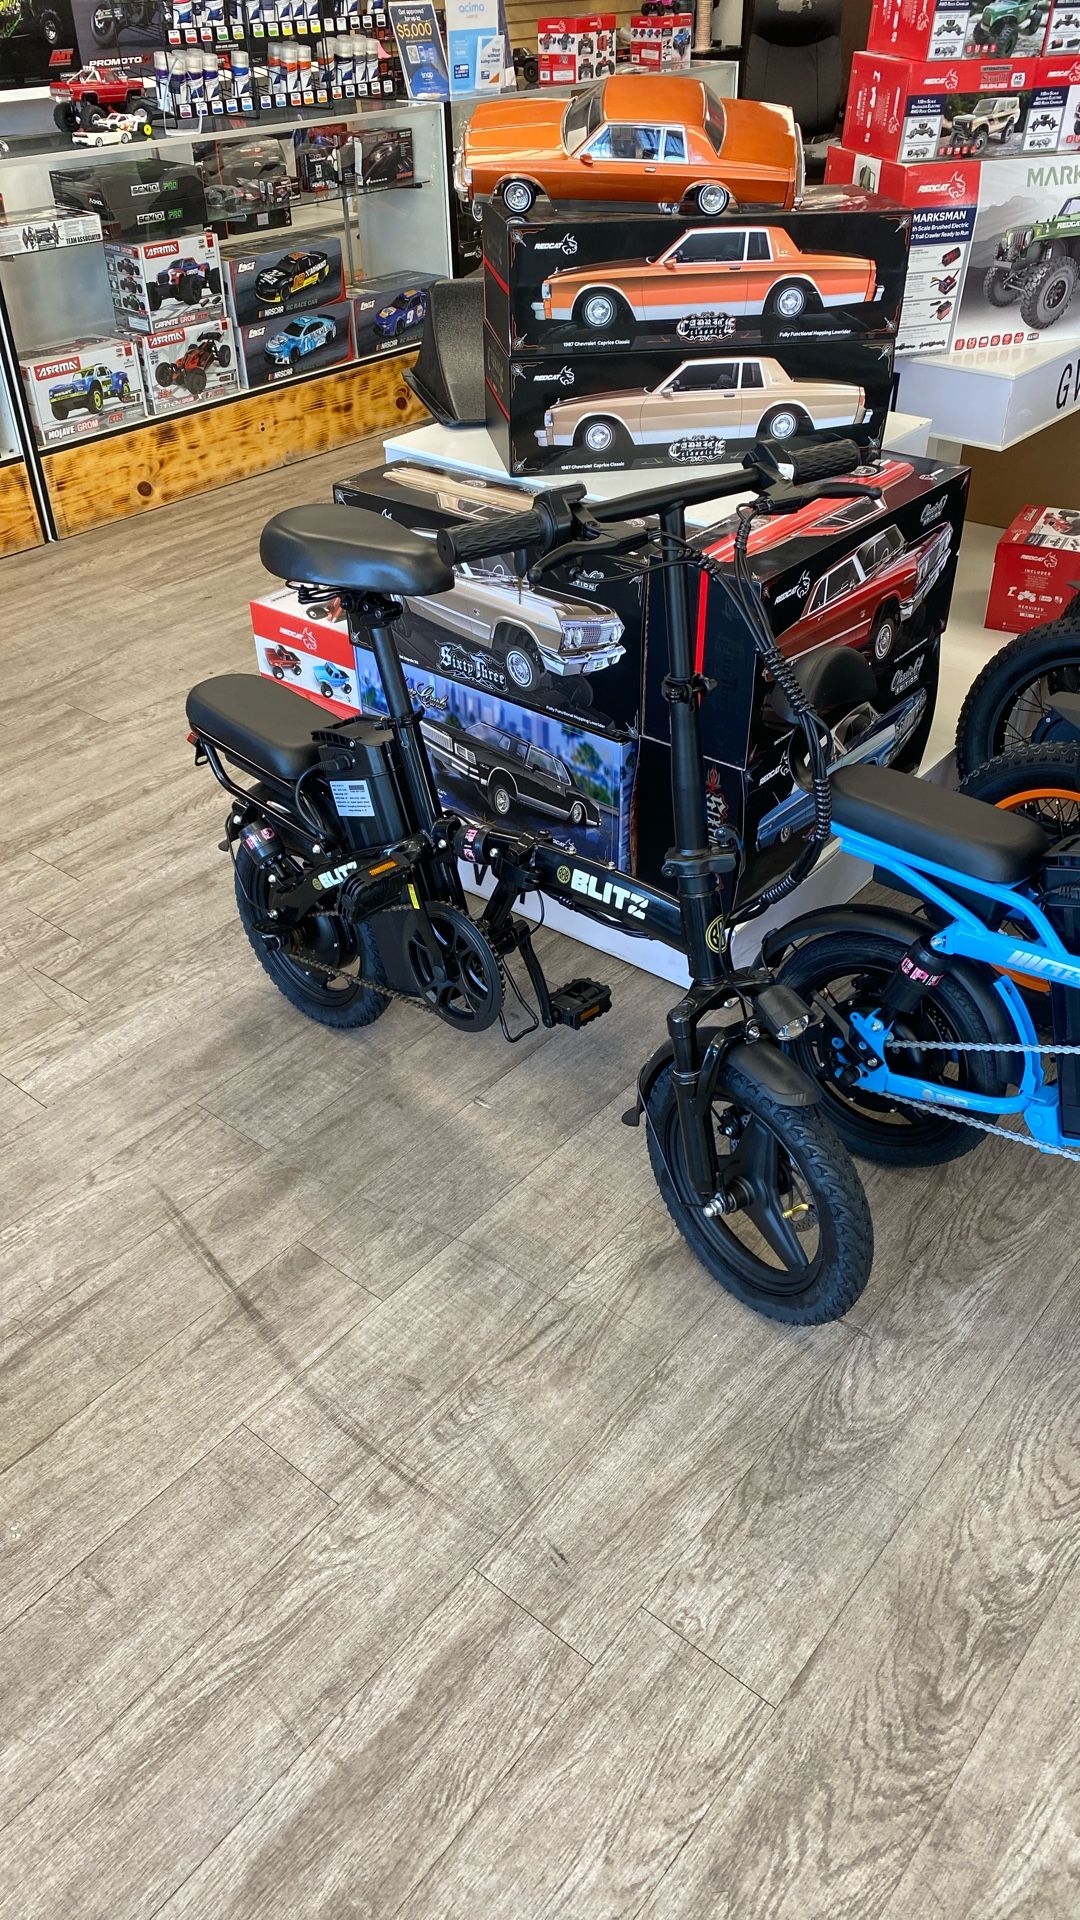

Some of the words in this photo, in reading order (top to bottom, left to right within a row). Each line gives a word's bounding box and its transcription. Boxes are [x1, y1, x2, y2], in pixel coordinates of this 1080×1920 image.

[458, 3, 485, 13] acima
[396, 22, 433, 39] $5,000
[89, 56, 142, 67] PROMOTO
[163, 181, 178, 190] PRO
[917, 183, 950, 193] REDCAT
[168, 208, 183, 220] PRO
[912, 210, 967, 223] MARKSMAN
[77, 233, 101, 242] ASSOCIATED
[941, 231, 955, 239] Ready
[145, 243, 177, 257] ARRMA
[534, 242, 563, 250] REDCAT
[264, 306, 284, 317] NASCAR
[294, 300, 307, 308] RACE
[406, 310, 414, 324] 9
[154, 318, 179, 329] GRANITE
[150, 331, 183, 346] ARRMA
[779, 330, 790, 338] Fully
[813, 330, 831, 338] Hopping
[380, 339, 398, 350] NASCAR
[37, 360, 78, 377] ARRMA
[273, 368, 293, 379] NASCAR
[48, 425, 76, 440] MOJAVE
[77, 419, 99, 432] GROM
[1020, 553, 1045, 562] REDCAT
[1024, 568, 1052, 576] INCLUDED
[774, 585, 799, 606] REDCAT
[279, 627, 304, 641] REDCAT
[440, 645, 474, 676] Sixty
[469, 654, 505, 684] Three
[570, 868, 649, 921] BLITZ
